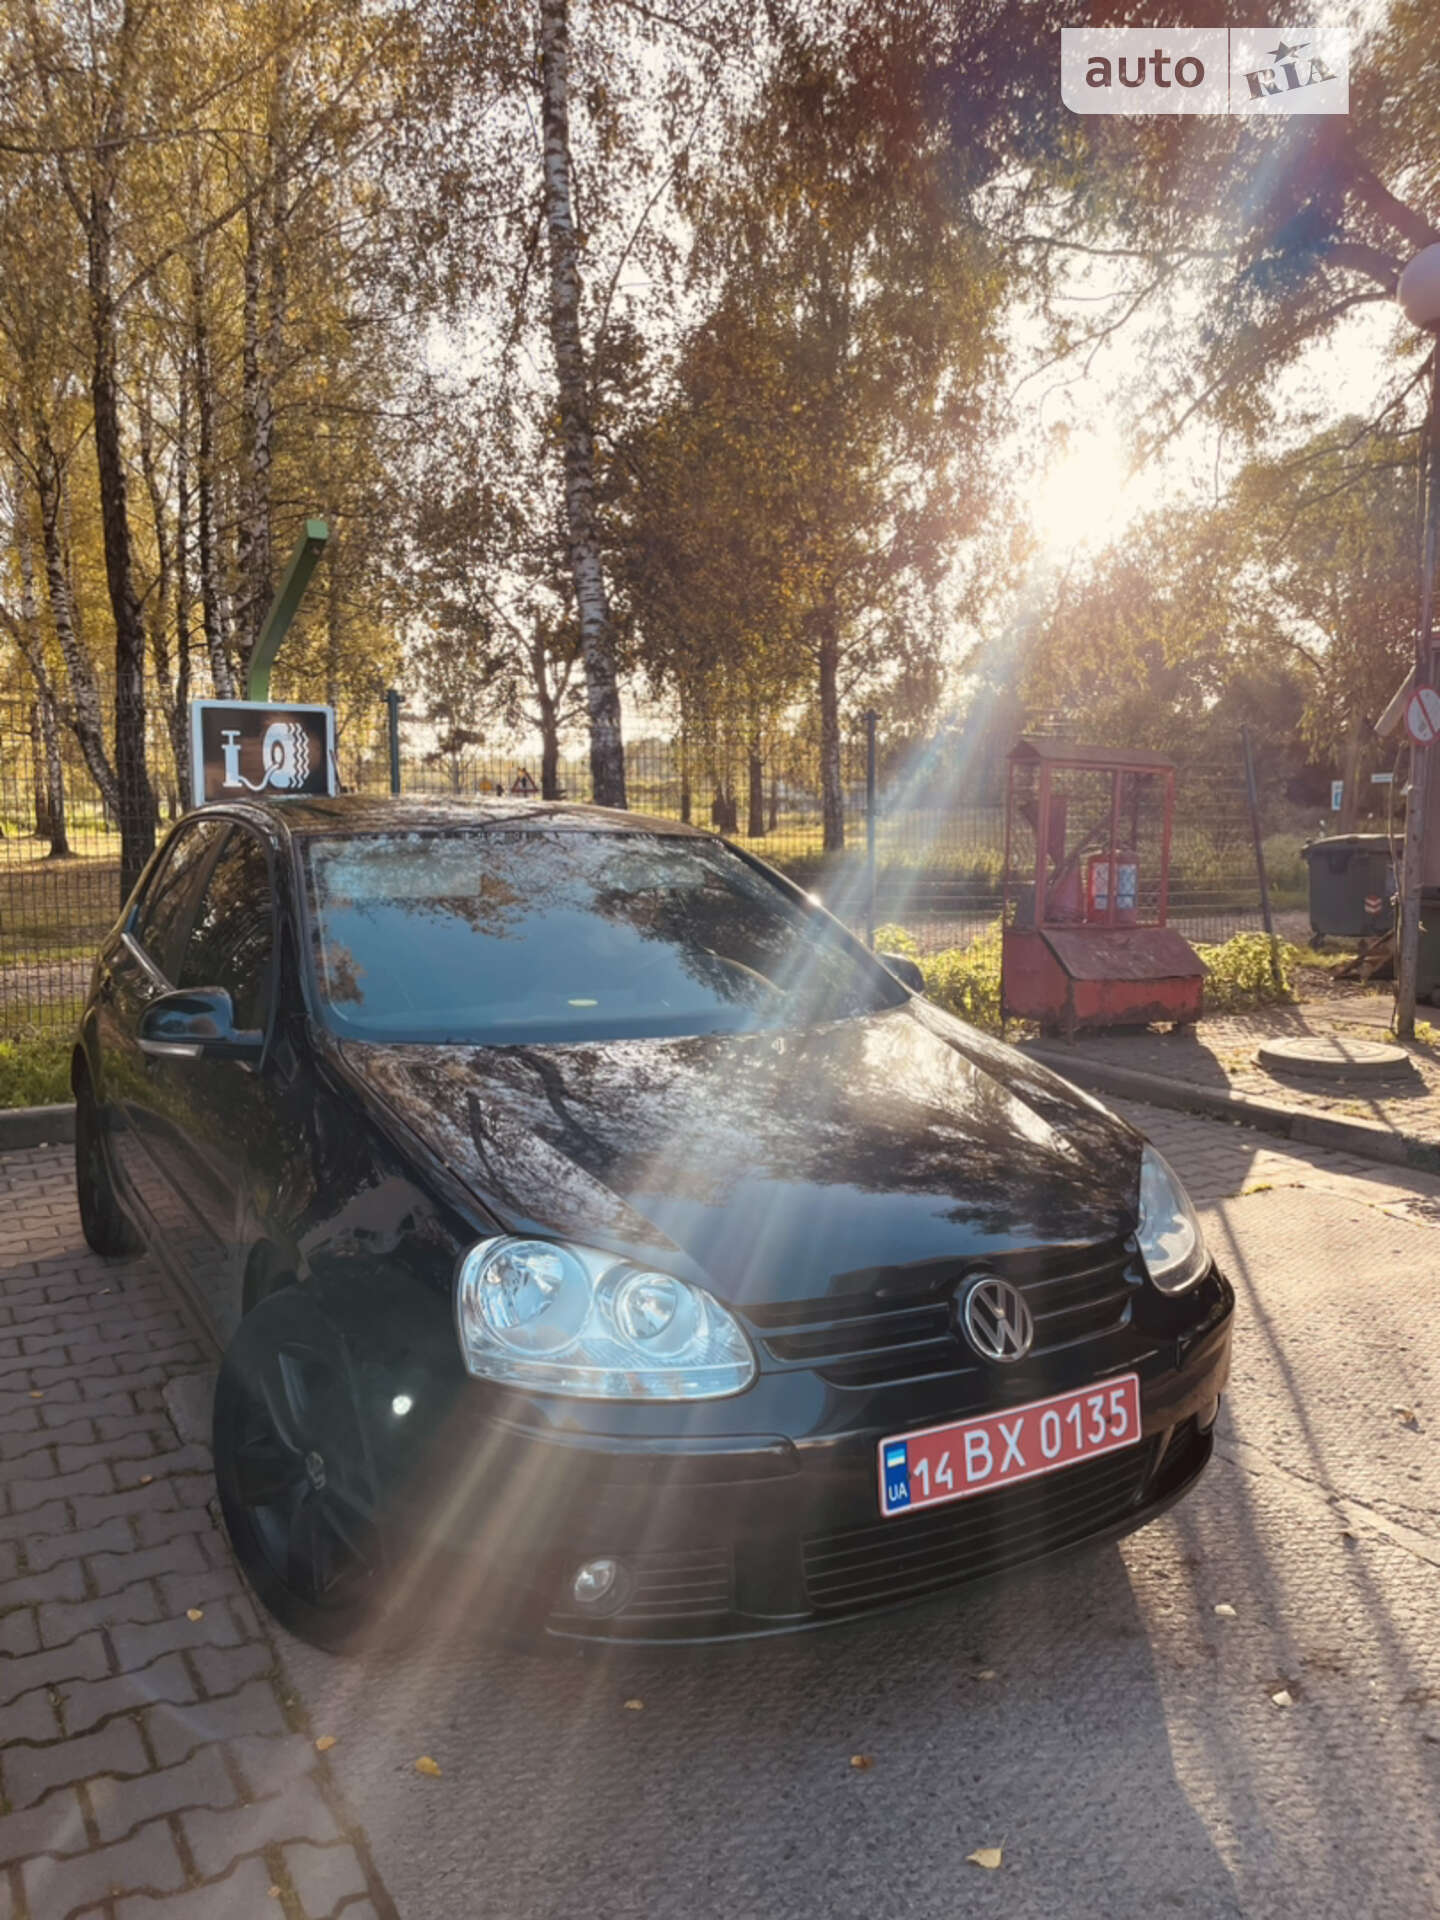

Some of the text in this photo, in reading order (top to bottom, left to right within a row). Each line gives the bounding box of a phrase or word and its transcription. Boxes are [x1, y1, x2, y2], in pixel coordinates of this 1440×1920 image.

[913, 1389, 1128, 1497] 14 BX 0135
[888, 1483, 908, 1501] UA
